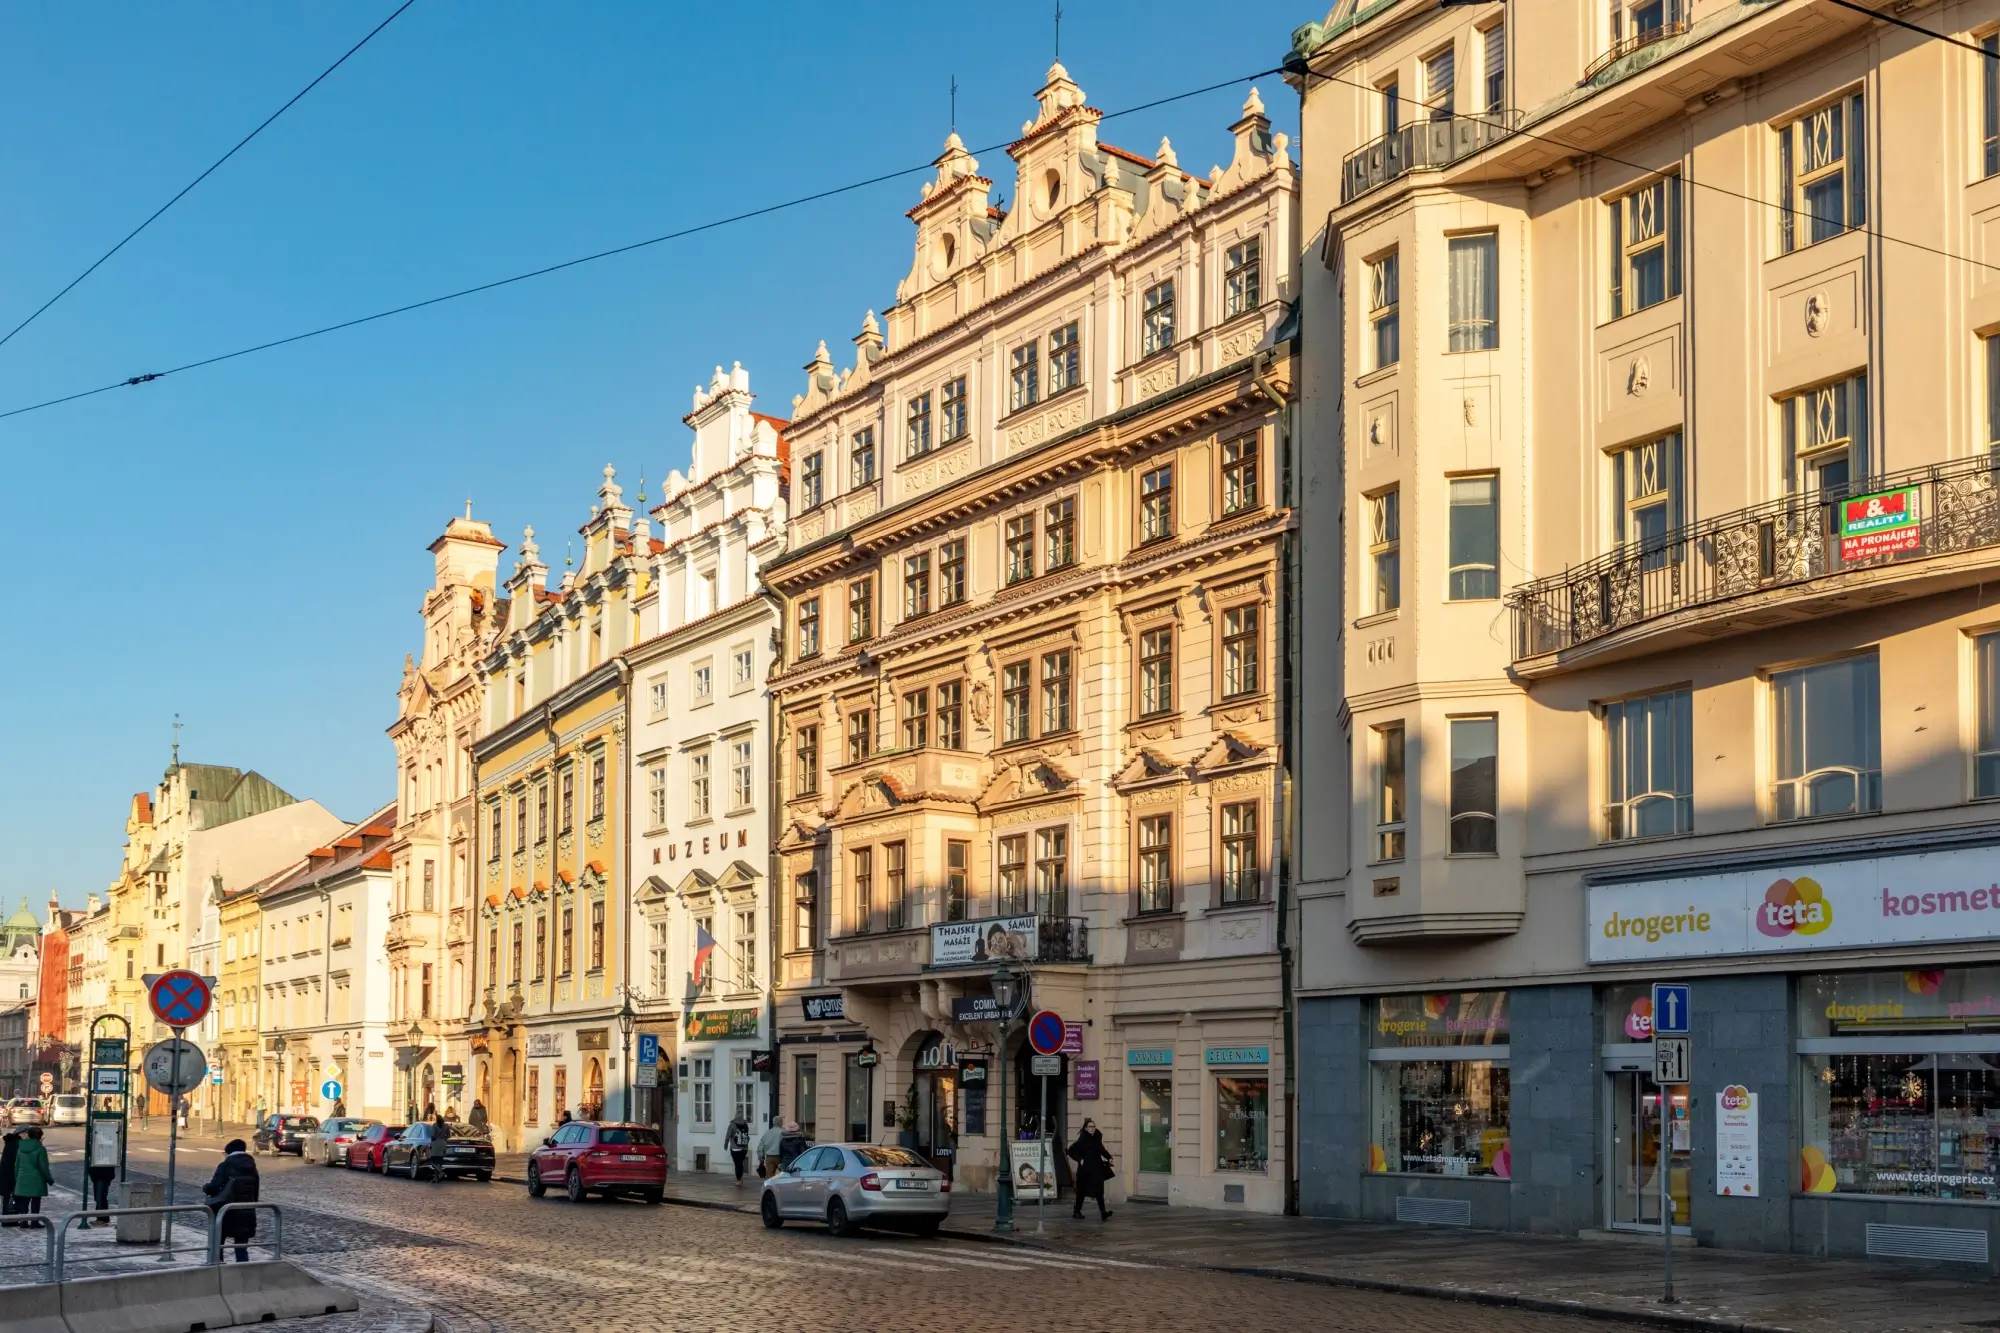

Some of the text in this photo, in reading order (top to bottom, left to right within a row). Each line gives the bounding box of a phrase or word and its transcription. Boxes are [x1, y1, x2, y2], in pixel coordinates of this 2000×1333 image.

[1847, 492, 1907, 523] M&M
[1848, 514, 1905, 531] REALITY
[1844, 529, 1917, 549] NA PRONÁJEM
[653, 829, 748, 865] MUZEUM
[1765, 898, 1825, 928] teta
[938, 922, 976, 937] THAJSKÉ
[1008, 919, 1036, 930] SAMUI
[1604, 905, 1711, 943] drogerie
[943, 934, 971, 947] MASÁŽE
[973, 1000, 997, 1010] COMIX
[1825, 1000, 1904, 1023] drogerie
[959, 1012, 983, 1020] EXCELENT
[1377, 1019, 1427, 1036] drogerie
[1135, 1052, 1165, 1062] OVOCE
[1209, 1049, 1263, 1061] ZELENINA
[1725, 1095, 1747, 1106] teta
[1402, 1153, 1477, 1165] www.tetadrogerie.cz
[1876, 1172, 1995, 1187] www.tetadrogerie.cz
